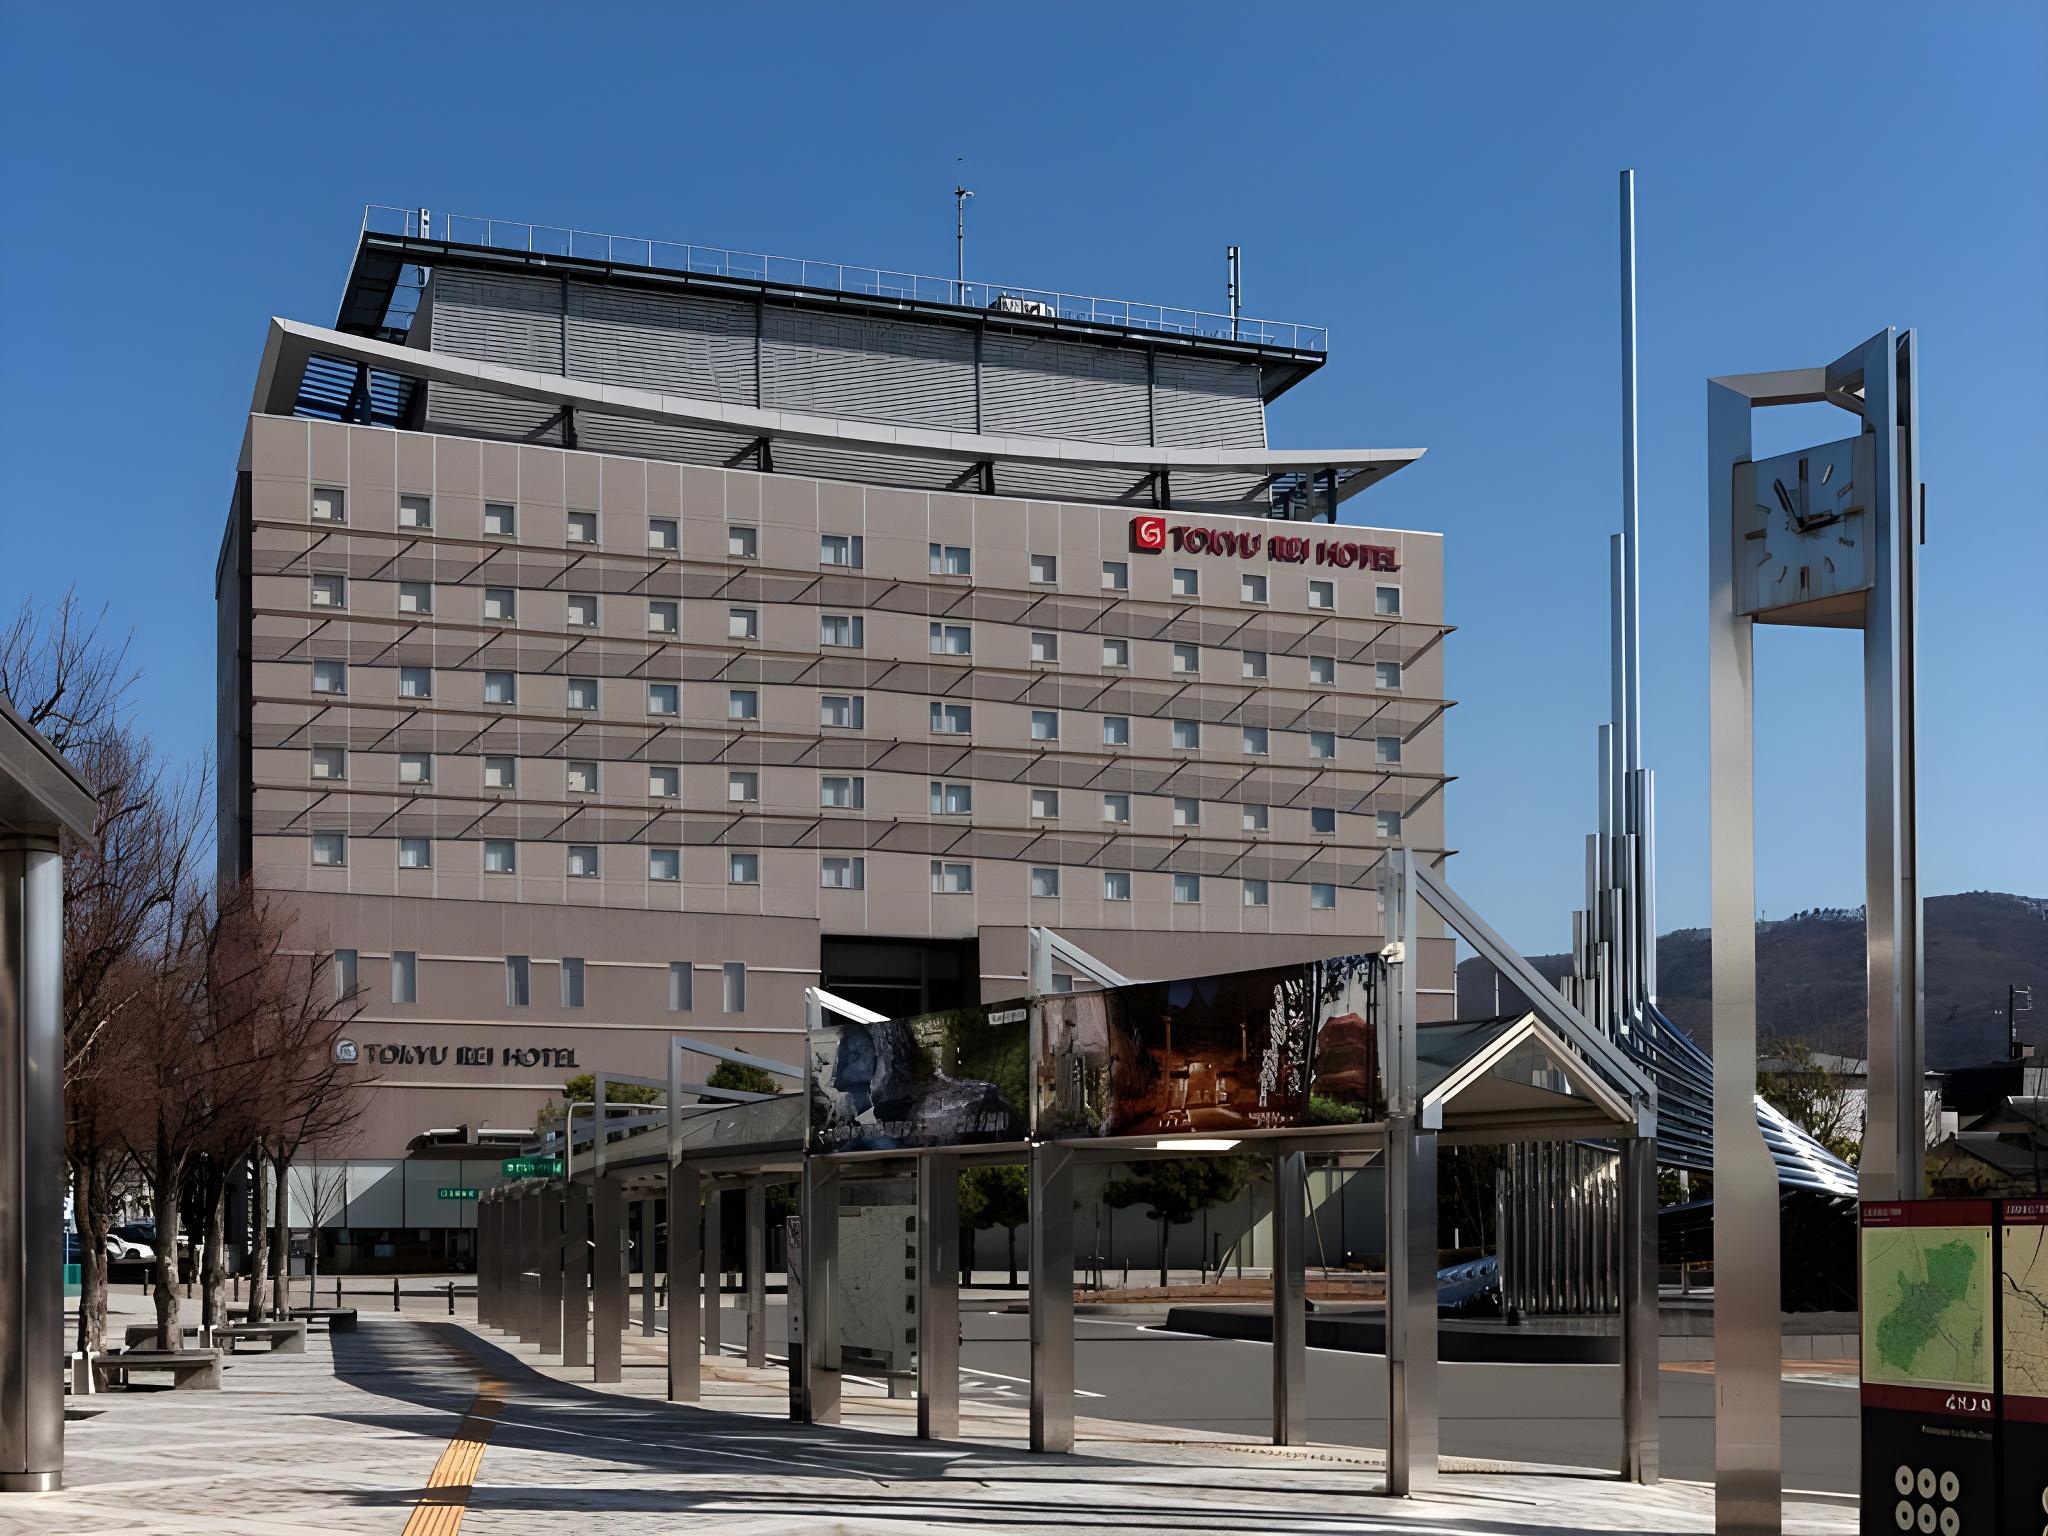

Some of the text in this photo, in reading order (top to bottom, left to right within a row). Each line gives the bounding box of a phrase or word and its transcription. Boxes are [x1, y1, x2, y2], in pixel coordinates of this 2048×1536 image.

[1168, 526, 1261, 560] TOKYU
[1316, 539, 1401, 572] HOTEL
[363, 1043, 448, 1066] TOKYU
[502, 1047, 580, 1068] HOTEL
